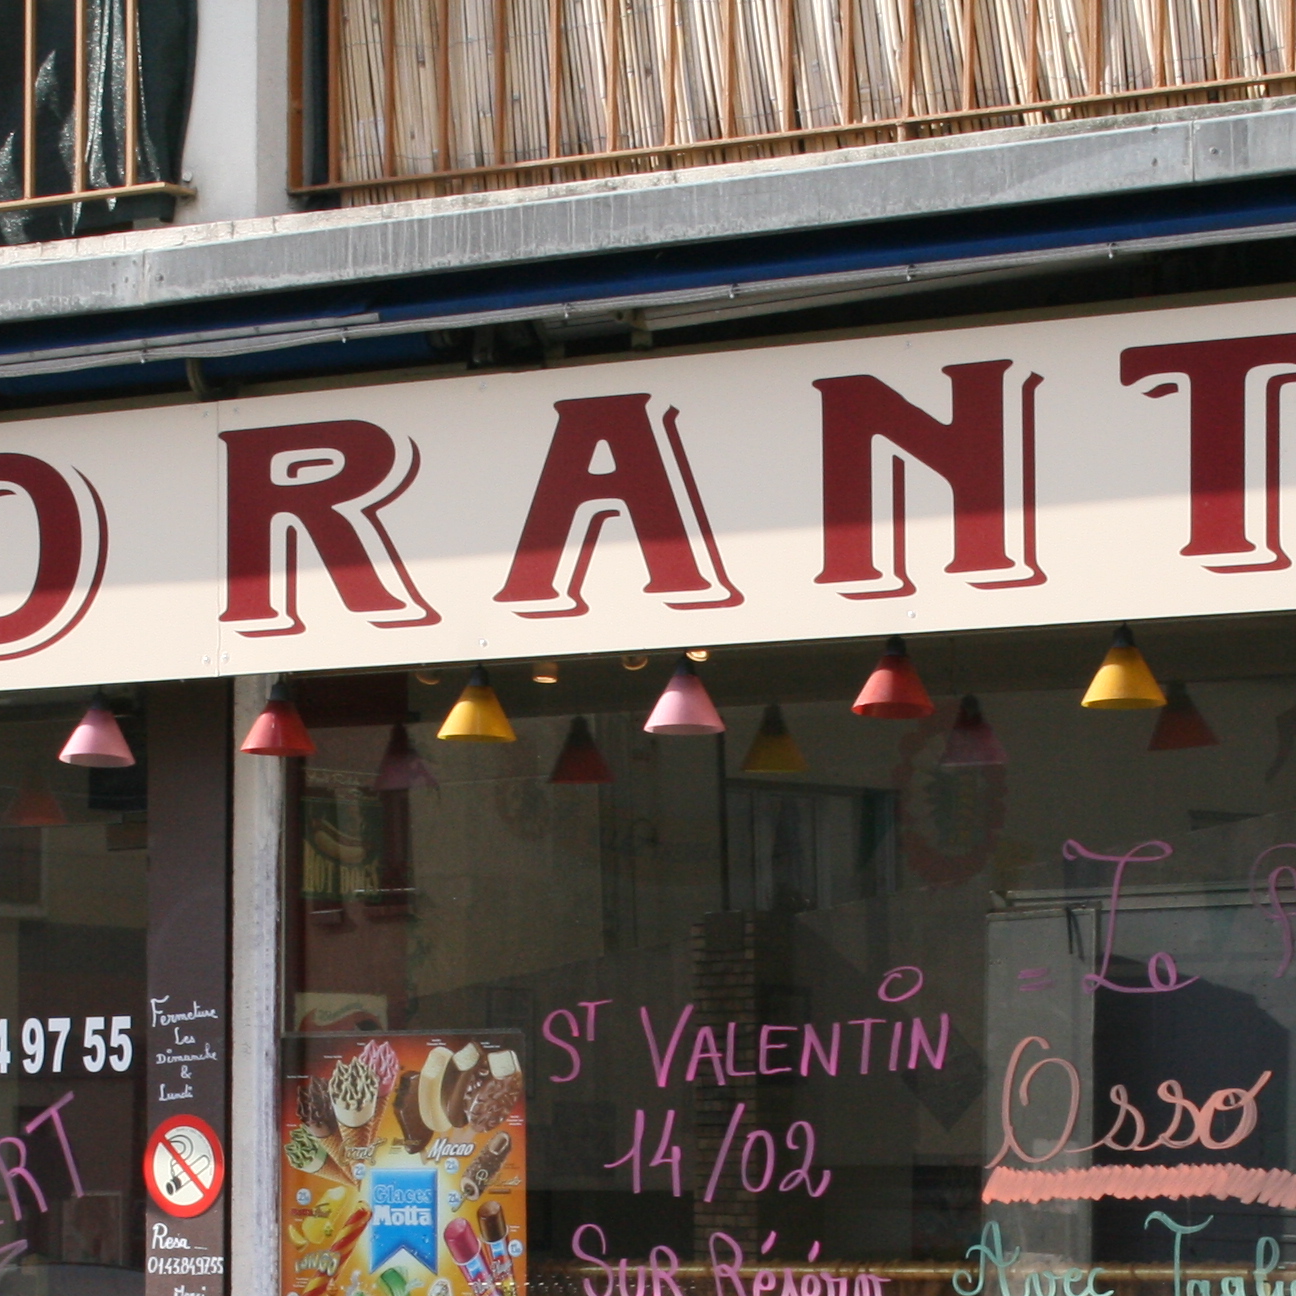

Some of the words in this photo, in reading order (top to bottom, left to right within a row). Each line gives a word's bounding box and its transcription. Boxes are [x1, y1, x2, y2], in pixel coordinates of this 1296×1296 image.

[427, 1138, 476, 1162] Macao
[374, 1184, 433, 1204] Glaces
[372, 1204, 433, 1226] Motta
